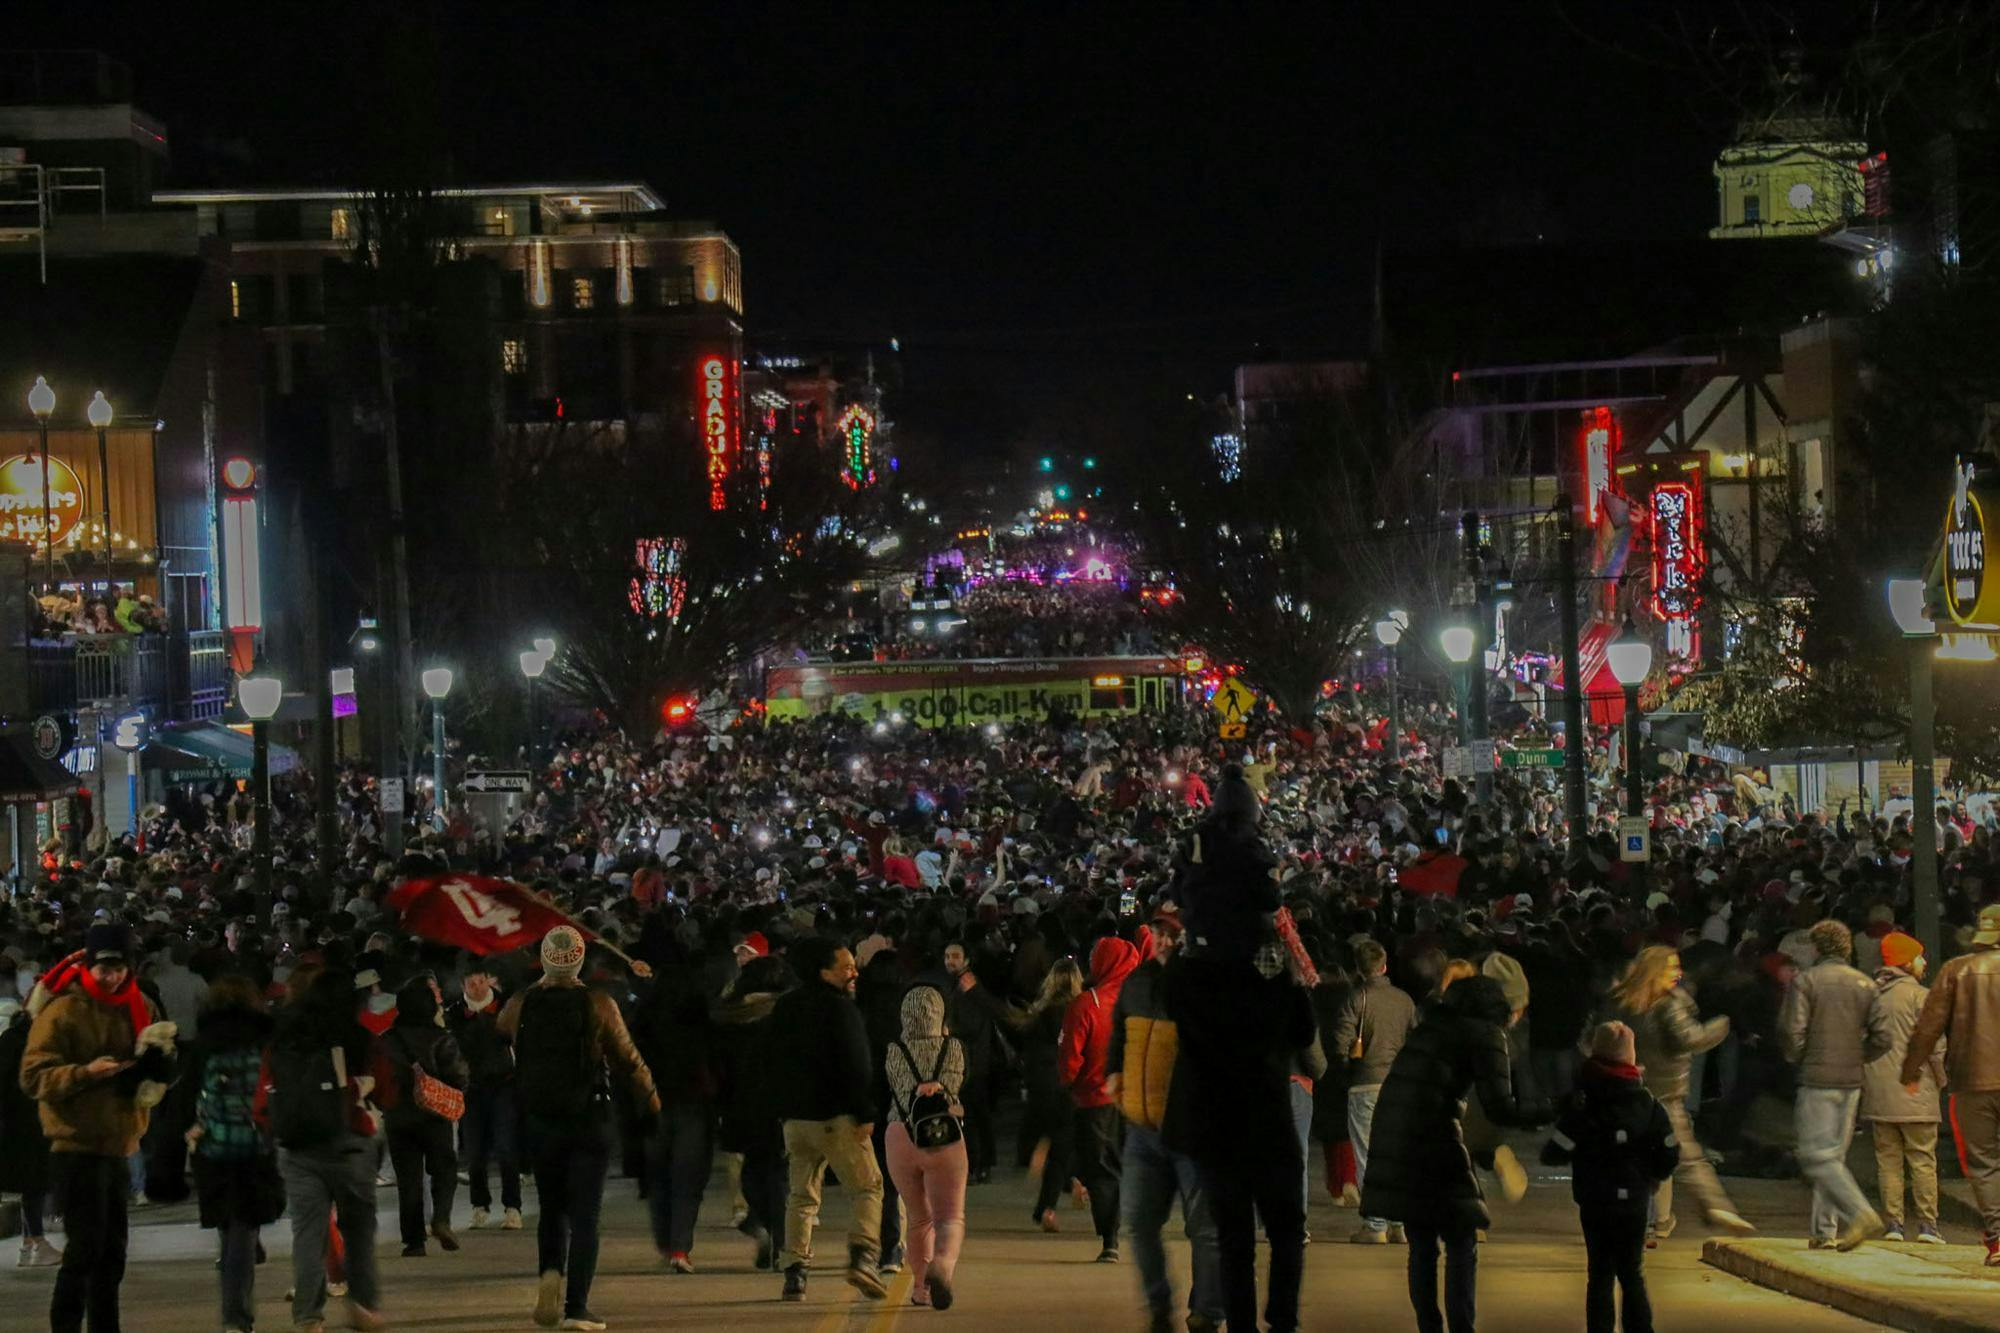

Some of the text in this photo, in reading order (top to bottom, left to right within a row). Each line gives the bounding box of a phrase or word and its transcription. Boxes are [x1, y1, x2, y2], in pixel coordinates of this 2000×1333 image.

[0, 490, 77, 513] pstirs
[1517, 752, 1548, 765] Dunn
[485, 777, 524, 788] ONE WAY
